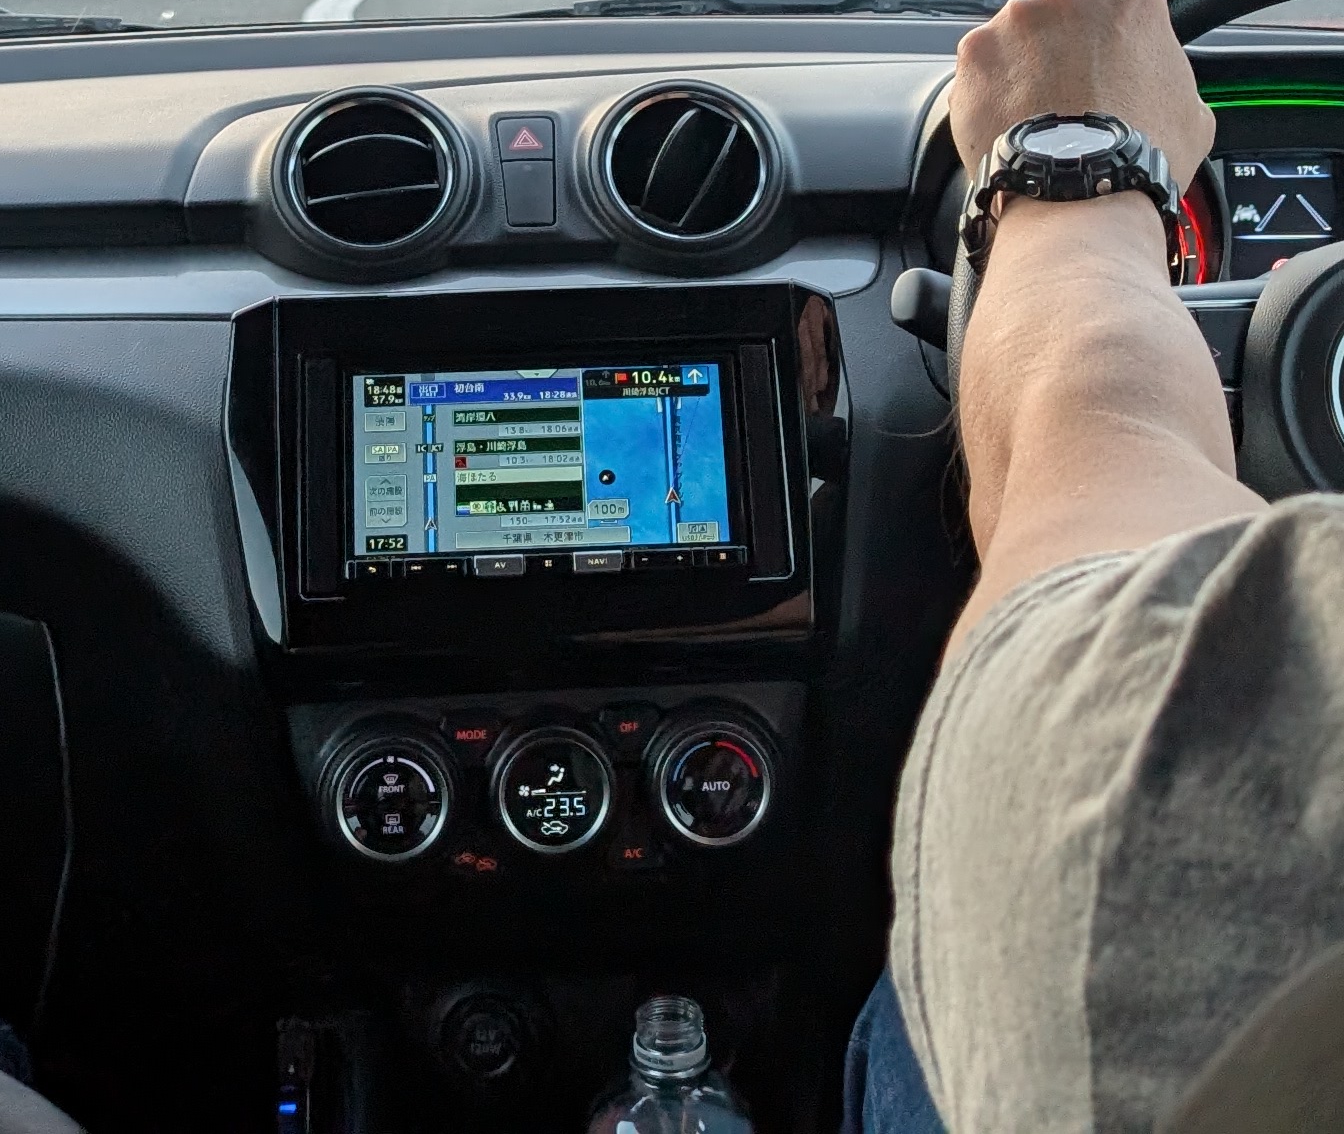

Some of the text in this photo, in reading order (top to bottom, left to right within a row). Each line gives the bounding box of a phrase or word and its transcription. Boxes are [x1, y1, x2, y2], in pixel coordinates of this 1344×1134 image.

[1234, 165, 1256, 177] 5:51
[454, 382, 485, 394] 初台南
[424, 474, 436, 482] PA
[456, 471, 497, 483] 海ほたる
[593, 503, 625, 515] 100m
[369, 537, 404, 549] 17:52
[494, 561, 507, 569] AV
[587, 558, 609, 566] NAVI
[620, 721, 639, 734] OFF
[456, 729, 487, 742] MODE
[378, 784, 405, 794] FRONT
[702, 780, 731, 792] AUTO
[544, 797, 586, 818] 23.5
[382, 825, 404, 835] REAR
[624, 847, 643, 860] A/C
